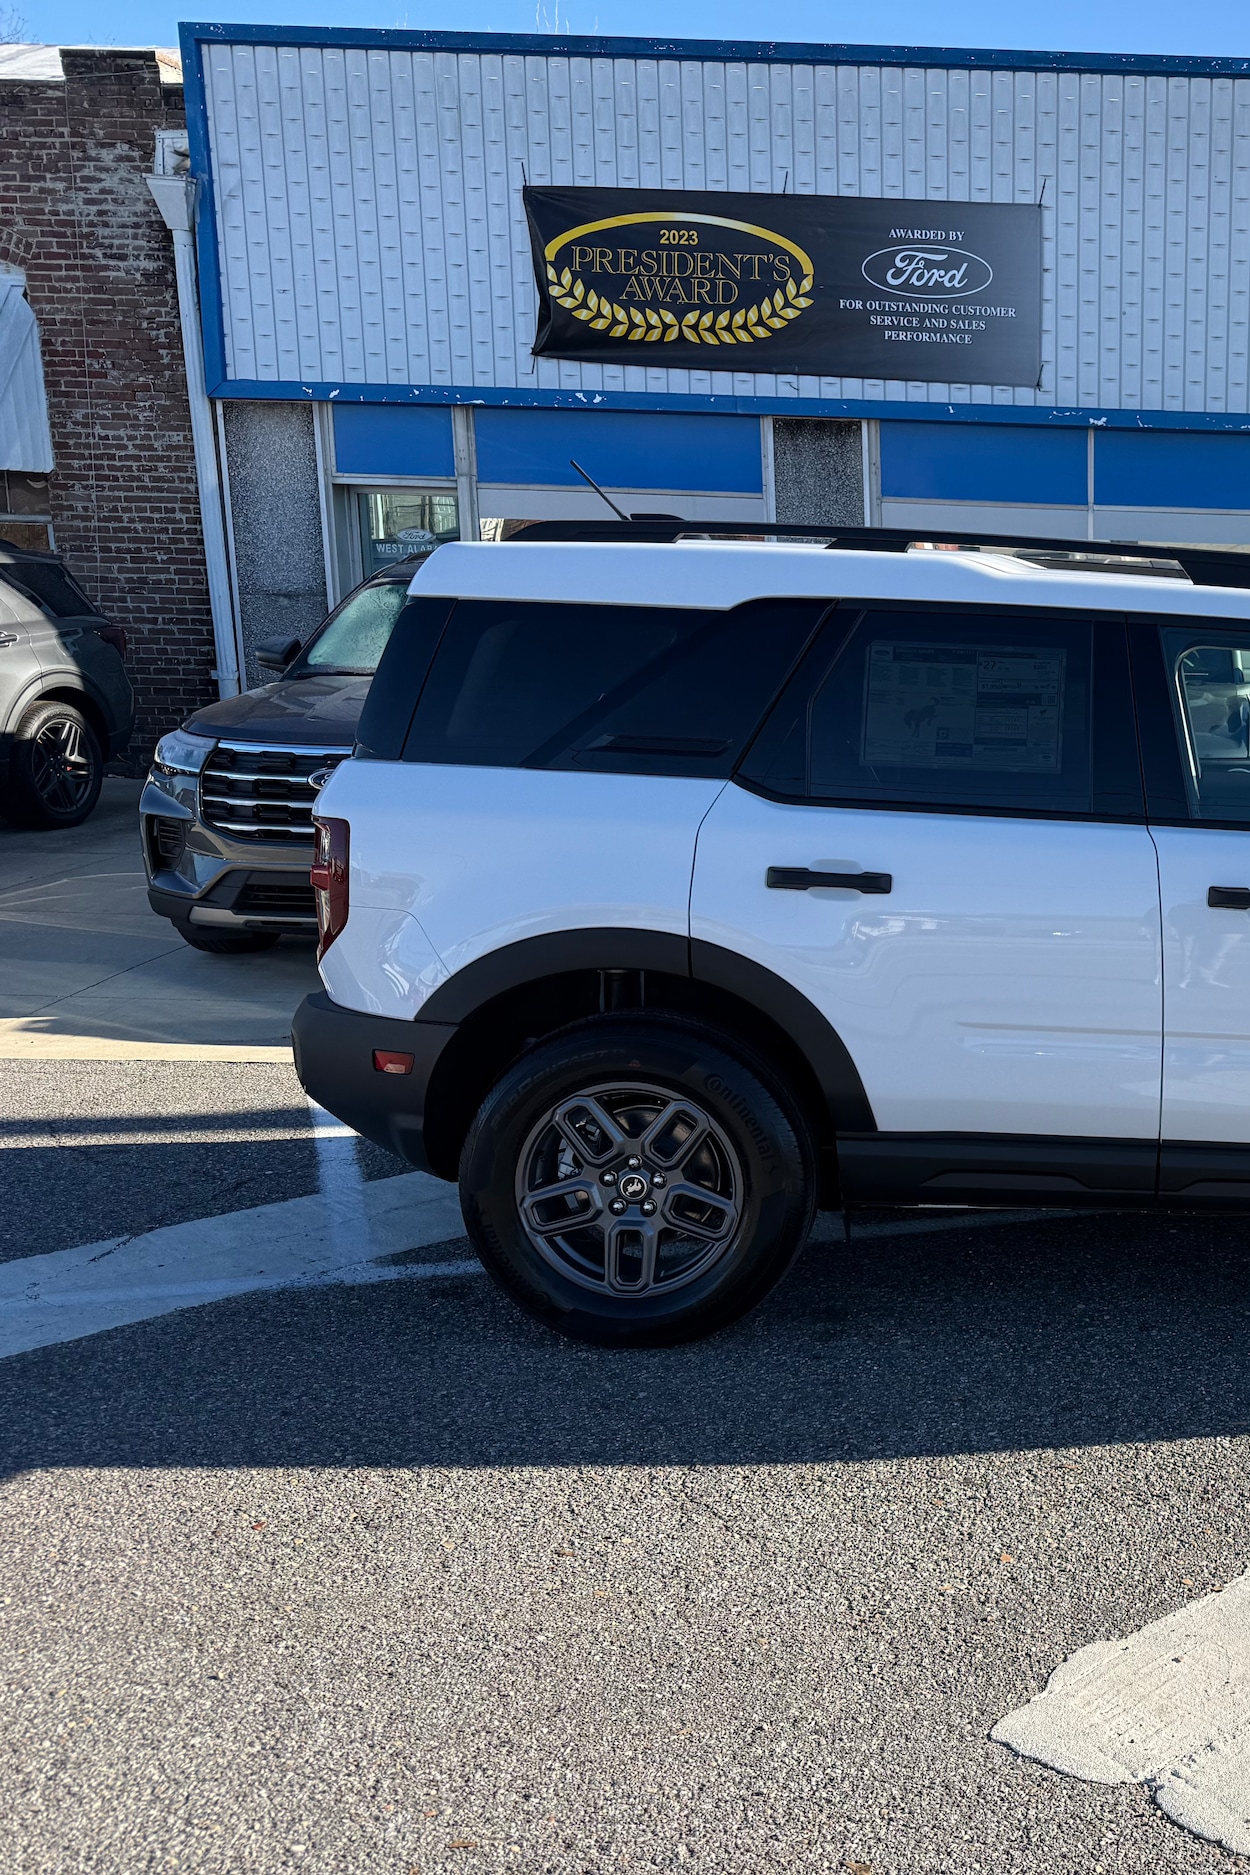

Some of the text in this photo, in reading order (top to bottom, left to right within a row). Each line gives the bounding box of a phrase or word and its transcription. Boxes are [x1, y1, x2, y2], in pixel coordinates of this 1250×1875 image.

[659, 229, 699, 246] 2023
[888, 228, 965, 241] AWARDED BY
[571, 245, 792, 282] PRESIDENT'S
[886, 251, 969, 288] Ford
[619, 275, 739, 305] AWARD
[839, 299, 1017, 318] FOR OUTSTANDING CUSTOMER
[869, 315, 986, 331] SERVICE AND SALES
[884, 330, 973, 344] PERFORMANCE
[402, 531, 426, 540] Ford
[375, 543, 404, 554] WEST
[983, 660, 996, 670] 27
